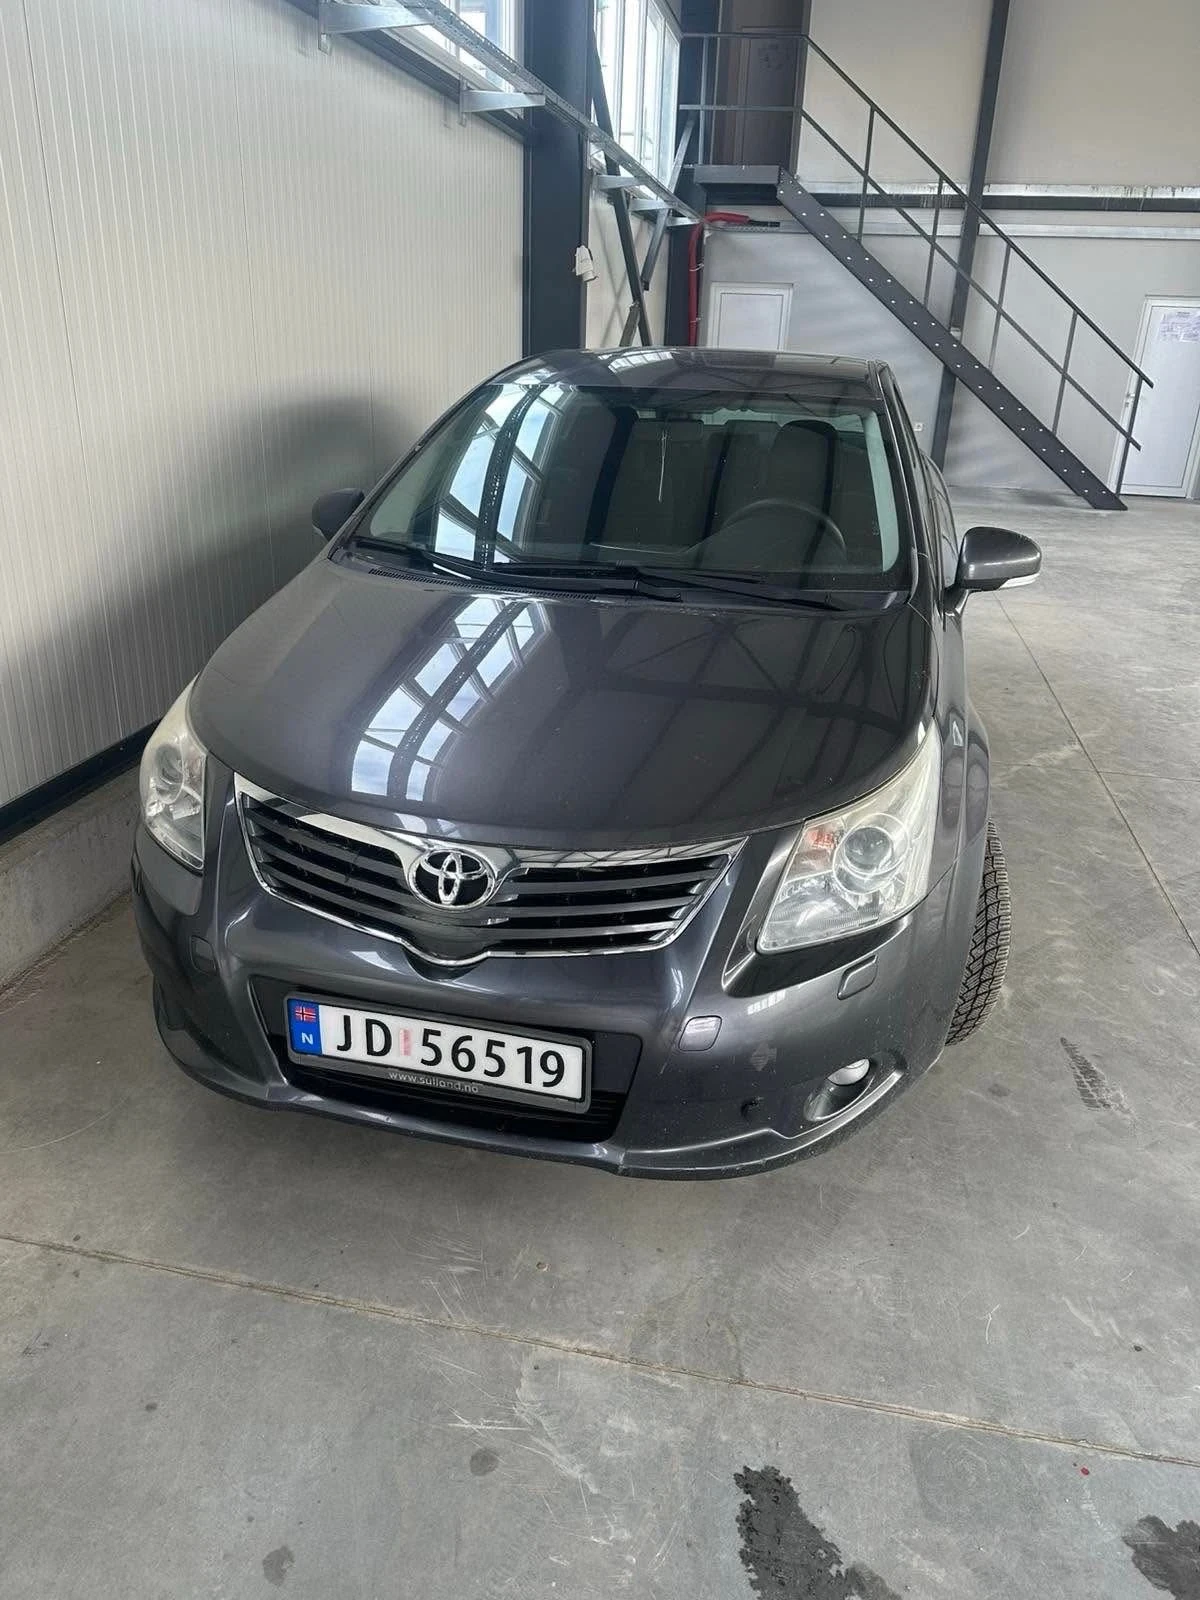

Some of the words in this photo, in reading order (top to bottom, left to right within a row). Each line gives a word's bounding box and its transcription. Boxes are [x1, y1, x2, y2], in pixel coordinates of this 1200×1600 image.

[301, 1032, 314, 1045] N
[337, 1015, 392, 1056] JD
[421, 1027, 566, 1088] 56519
